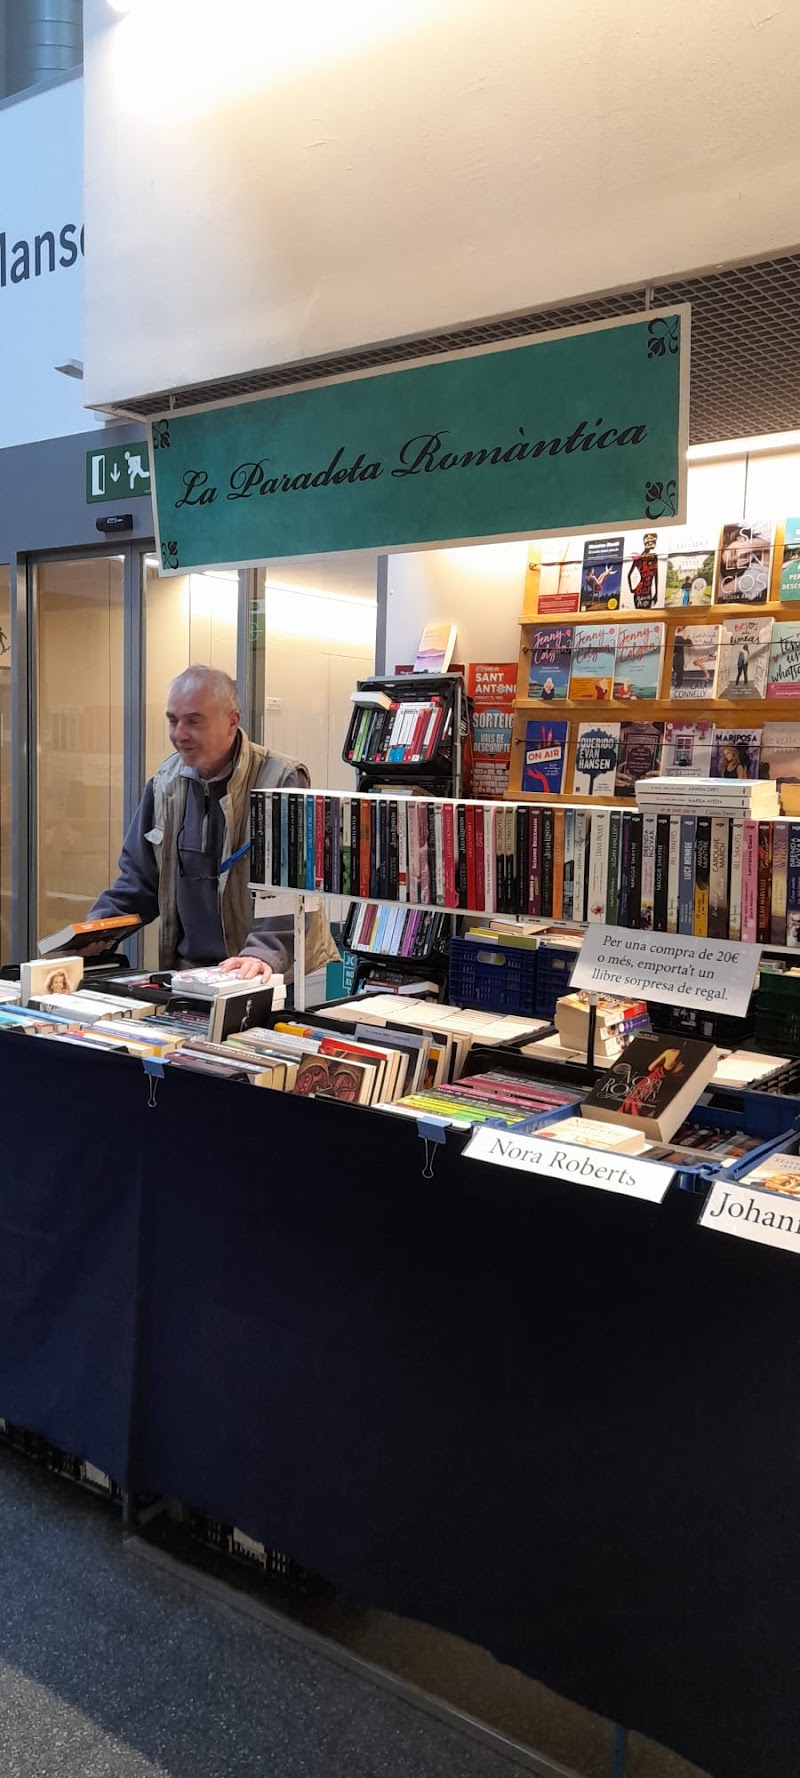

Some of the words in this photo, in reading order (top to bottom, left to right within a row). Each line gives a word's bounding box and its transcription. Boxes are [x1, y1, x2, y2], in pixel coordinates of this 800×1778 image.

[0, 222, 84, 287] ans
[175, 470, 218, 508] La
[227, 446, 384, 500] Paradeta
[391, 418, 648, 477] Romàntica
[721, 574, 767, 594] CIOS
[534, 629, 565, 648] Jenny
[576, 628, 608, 651] Jenny
[620, 627, 652, 649] Jenny
[475, 672, 504, 682] SANT
[673, 690, 707, 698] CONNELLY
[580, 737, 614, 749] QUERIDO
[716, 734, 757, 743] MARIPOSA
[528, 753, 541, 761] ON
[544, 749, 559, 758] AIR
[580, 748, 600, 759] EVAN
[578, 759, 610, 769] HANSEN
[544, 842, 552, 859] JULIA
[684, 841, 692, 865] MONROE
[684, 866, 692, 880] LUCY
[602, 935, 623, 947] Per
[625, 941, 646, 952] una
[650, 944, 695, 959] compra
[698, 949, 713, 961] de
[716, 950, 741, 964] 20€
[597, 954, 605, 963] o
[607, 954, 634, 968] més,
[637, 959, 695, 976] emporta't
[698, 968, 715, 979] un
[591, 967, 621, 983] llibre
[624, 976, 674, 992] sorpresa
[677, 982, 692, 994] de
[695, 986, 728, 1001] regal.
[488, 1137, 543, 1165] Nora
[548, 1150, 637, 1187] Roberts
